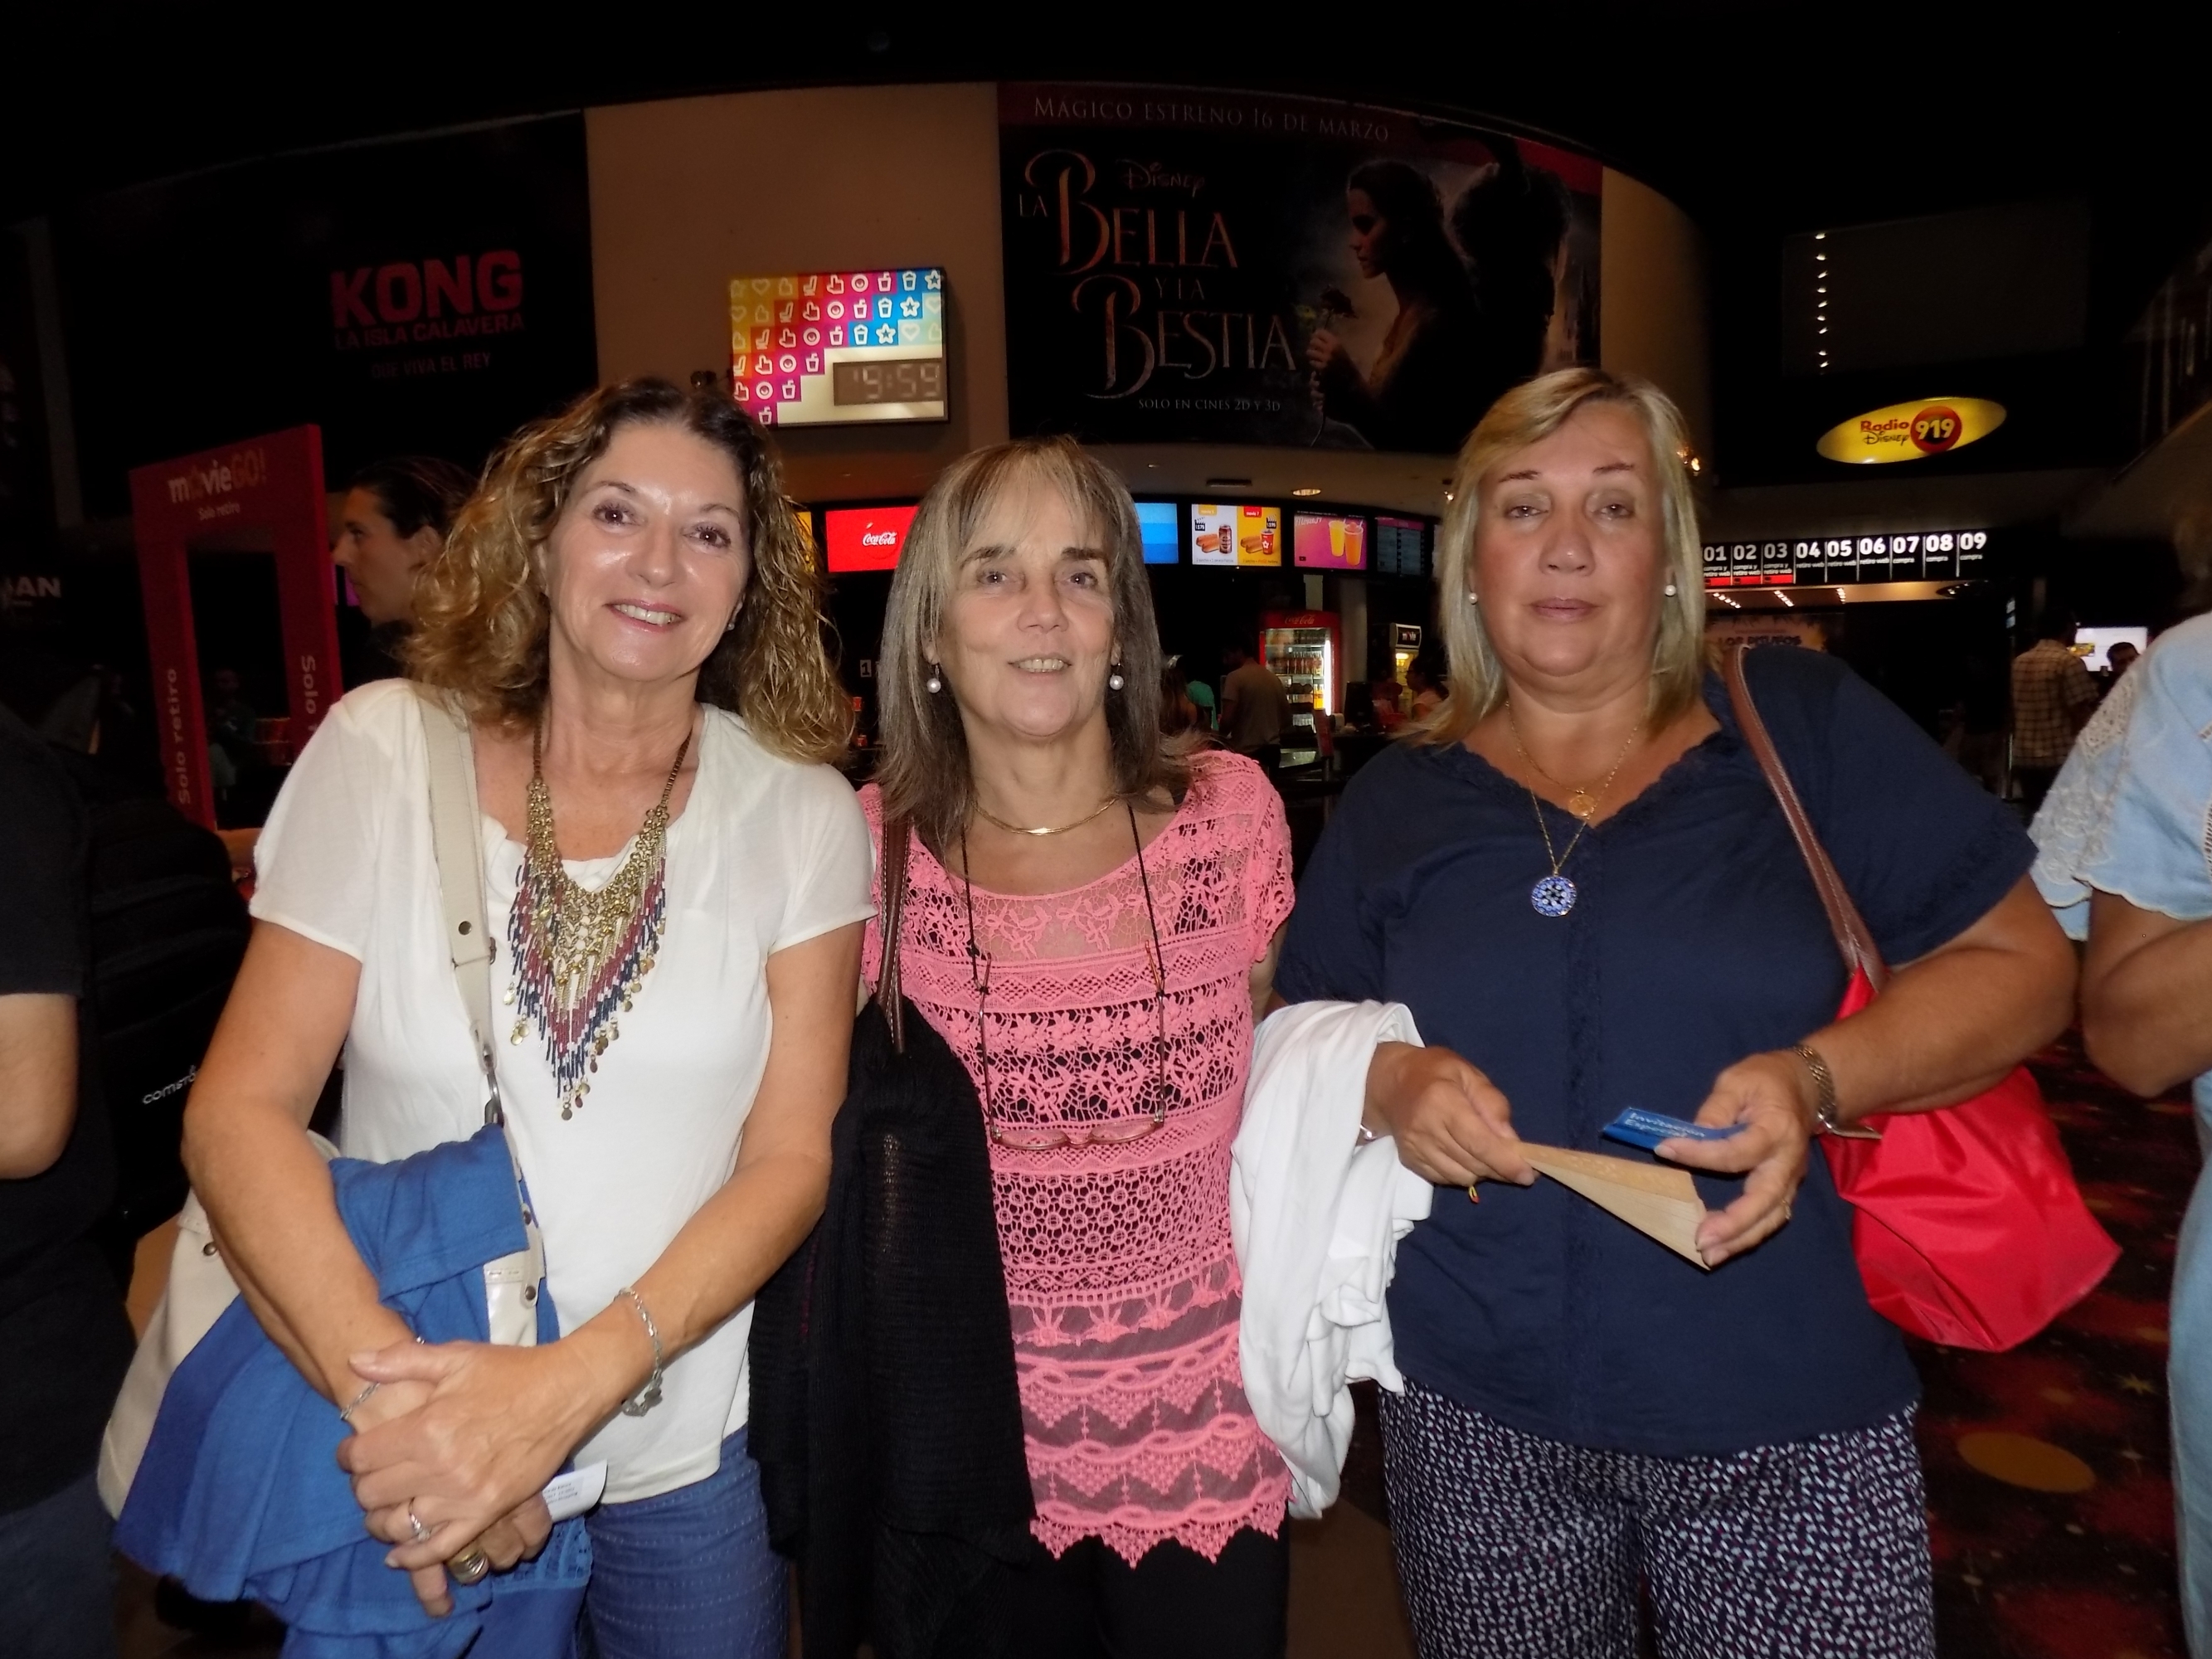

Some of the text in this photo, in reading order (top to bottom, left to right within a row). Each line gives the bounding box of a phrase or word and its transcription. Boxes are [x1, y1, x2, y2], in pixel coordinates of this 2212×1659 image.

[1145, 102, 1242, 127] ESTRENO
[1253, 107, 1273, 129] 16
[1284, 113, 1310, 134] DE
[1319, 118, 1389, 143] MARZO
[1018, 192, 1050, 218] LA
[1024, 147, 1239, 277] BELLA
[329, 249, 524, 329] KONG
[1154, 276, 1169, 300] Y
[333, 311, 525, 352] LA ISLA CALAVERA
[1069, 273, 1297, 400] BESTIA
[371, 351, 492, 380] QUE VIVA EL REY
[1138, 399, 1281, 411] SOLO EN CINES 2D Y 3D
[1860, 419, 1909, 433] Radio
[1796, 542, 1821, 558] 04
[1826, 540, 1853, 557] 05
[1860, 538, 1886, 555] 06
[1893, 536, 1920, 553] 07
[1926, 534, 1954, 552] 08
[1960, 533, 1987, 550] 09
[1703, 546, 1728, 562] 01
[1733, 544, 1757, 560] 02
[1763, 543, 1788, 558] 03
[861, 662, 870, 676] 1
[300, 655, 319, 715] Solo
[167, 668, 191, 805] Solo retiro
